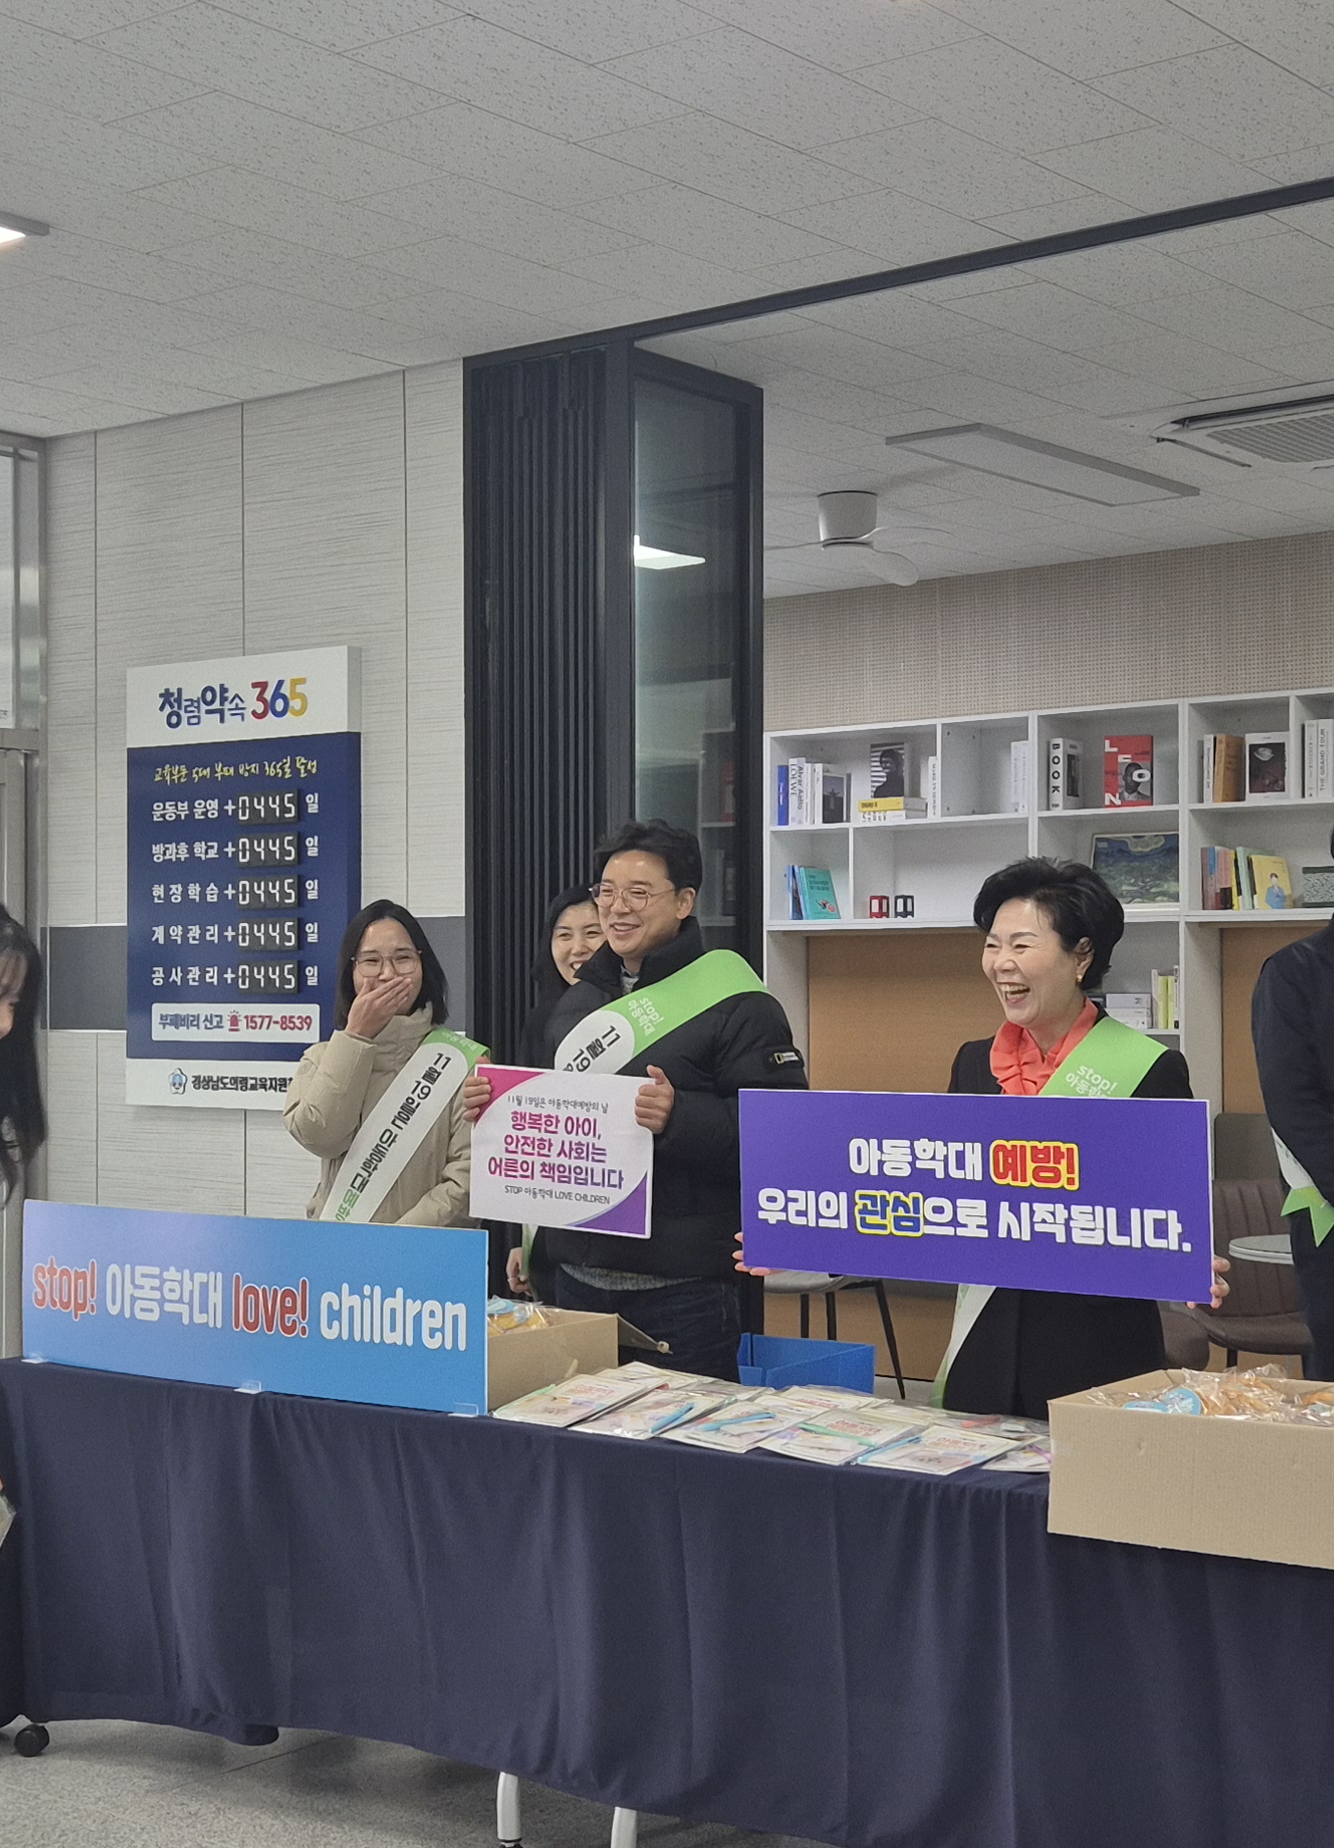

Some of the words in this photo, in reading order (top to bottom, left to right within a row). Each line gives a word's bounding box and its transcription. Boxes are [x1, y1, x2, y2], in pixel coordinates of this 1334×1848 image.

[158, 683, 247, 729] 청렴약속
[251, 677, 308, 720] 365
[263, 755, 292, 779] 365일
[151, 801, 189, 822] 운동부
[193, 798, 219, 820] 운영
[305, 792, 319, 814] 일
[151, 842, 189, 863] 방과후
[193, 841, 219, 861] 학교
[305, 835, 319, 857] 일
[305, 879, 319, 900] 일
[305, 922, 319, 943] 일
[305, 965, 319, 986] 일
[158, 1013, 201, 1031] 부패비리
[202, 1013, 224, 1029] 신고
[243, 1014, 313, 1031] 1577-8539
[627, 999, 656, 1037] 아동학대
[638, 996, 666, 1025] stop!
[585, 1024, 622, 1062] 11월
[421, 1052, 452, 1086] 11월
[1077, 1065, 1118, 1095] stop!
[390, 1080, 432, 1131] 19일은
[510, 1110, 561, 1135] 행복한
[564, 1115, 602, 1141] 아이,
[349, 1128, 399, 1194] 아동학대
[503, 1134, 554, 1159] 안전한
[556, 1139, 607, 1164] 사회는
[848, 1137, 983, 1181] 아동학대
[990, 1139, 1080, 1191] 예방!
[488, 1156, 535, 1181] 어른의
[539, 1161, 625, 1190] 책임입니다
[504, 1184, 523, 1195] STOP
[524, 1186, 554, 1200] 아동학대
[554, 1190, 574, 1201] LOVE
[574, 1192, 611, 1205] CHILDREN
[757, 1187, 848, 1230] 우리의
[854, 1189, 989, 1239] 관심으로
[997, 1200, 1192, 1253] 시작됩니다.
[32, 1255, 97, 1322] stop!
[105, 1262, 223, 1329] 아동학대
[232, 1272, 309, 1339] love!
[319, 1282, 467, 1352] children
